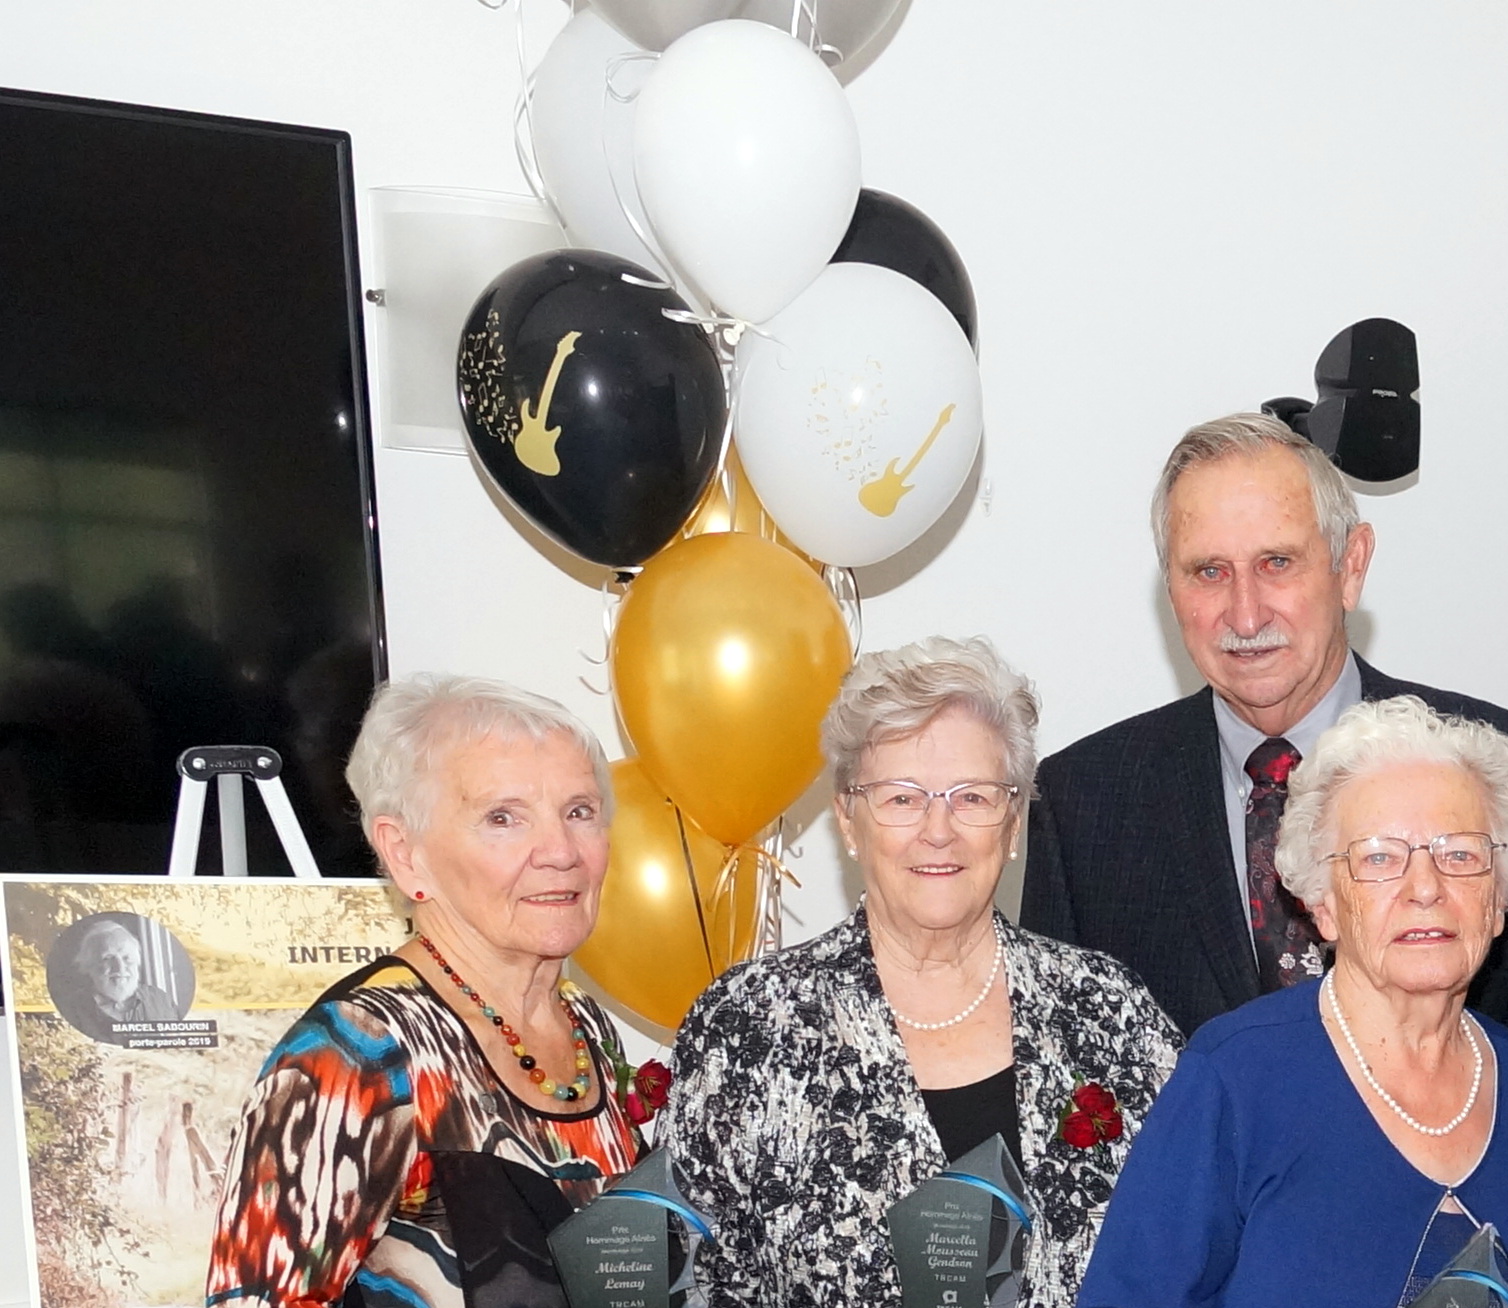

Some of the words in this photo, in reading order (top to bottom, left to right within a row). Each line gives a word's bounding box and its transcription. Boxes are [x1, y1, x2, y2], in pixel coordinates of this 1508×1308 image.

[112, 1022, 155, 1032] MARCEL
[129, 1038, 186, 1048] porte-parole
[925, 1232, 977, 1246] Marcella
[595, 1261, 653, 1274] Micheline
[604, 1278, 645, 1291] Lemay
